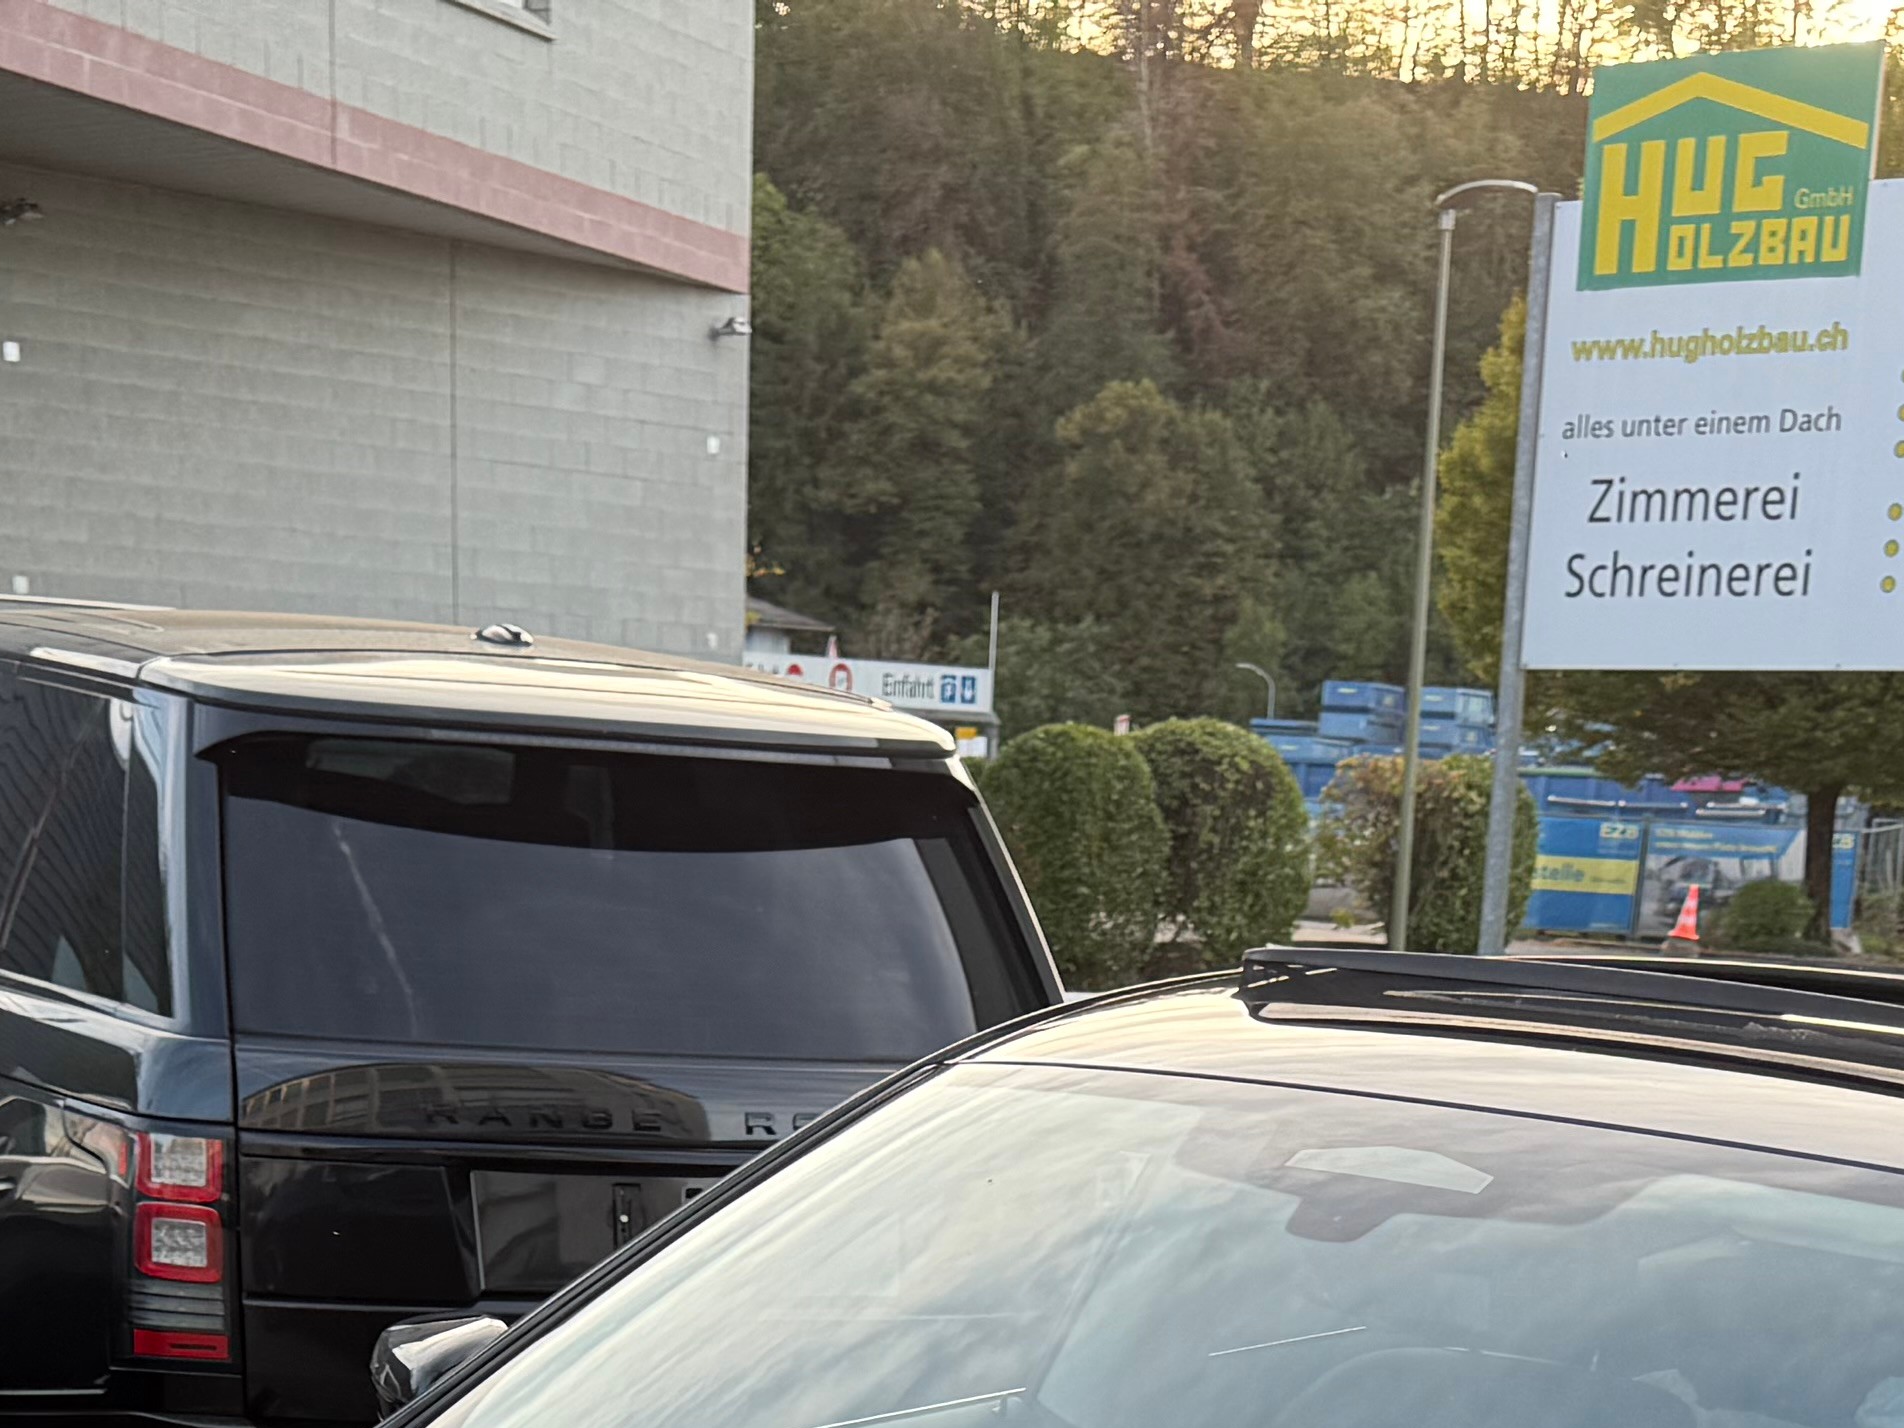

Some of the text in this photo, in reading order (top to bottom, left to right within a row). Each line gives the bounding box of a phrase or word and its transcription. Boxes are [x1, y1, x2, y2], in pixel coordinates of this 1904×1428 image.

[1794, 186, 1854, 209] GmbH
[1571, 321, 1849, 363] www.hugholzbau.ch
[1561, 406, 1842, 439] alles unter einem Dach
[1587, 472, 1801, 523] Zimmerei
[1564, 549, 1813, 598] Schreinerei
[425, 1108, 662, 1133] RANGE
